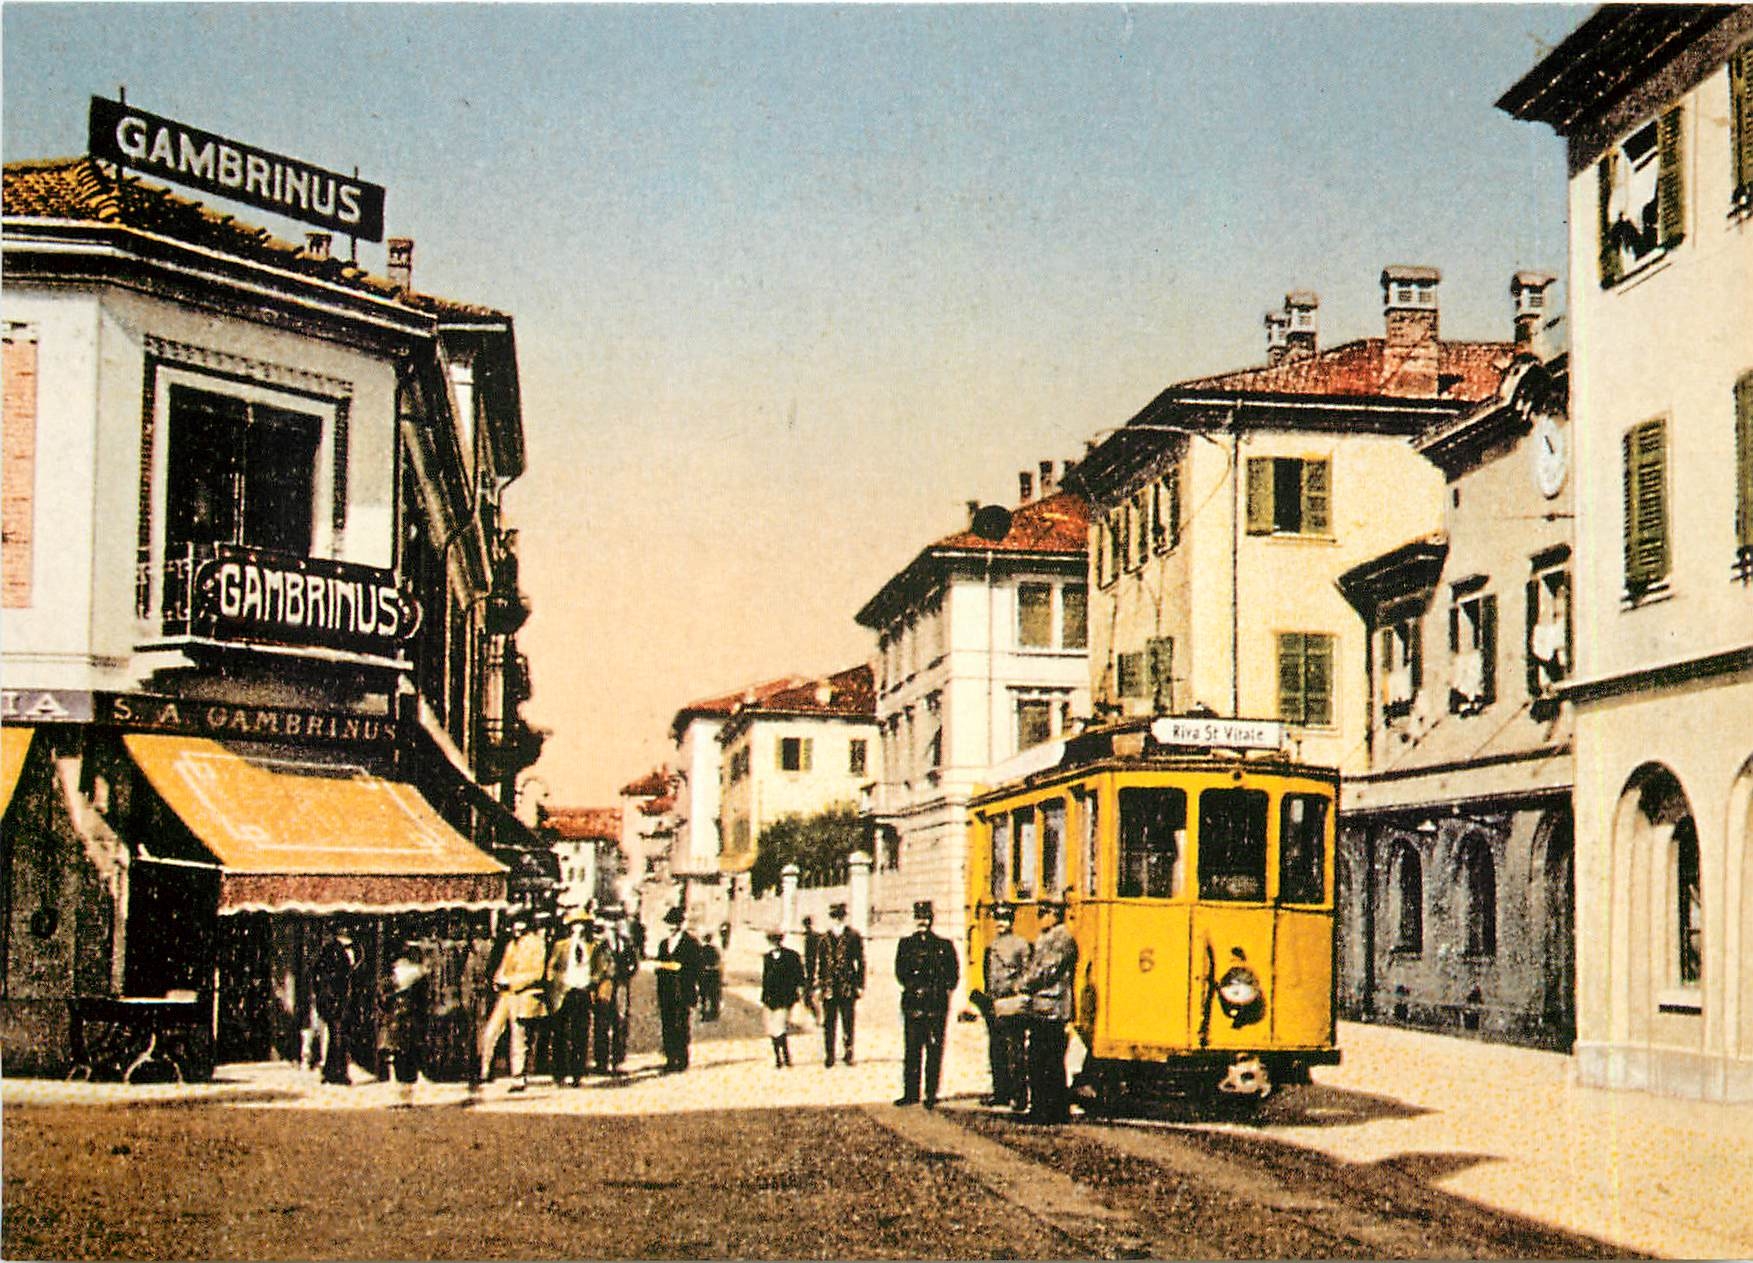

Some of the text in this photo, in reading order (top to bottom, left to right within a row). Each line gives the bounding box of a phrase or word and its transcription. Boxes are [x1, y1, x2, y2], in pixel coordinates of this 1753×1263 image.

[116, 117, 362, 224] GAMBRINUS
[220, 563, 401, 636] GAMBRINUS
[206, 706, 397, 741] GAMBRINUS
[1172, 724, 1200, 740] Riva
[1138, 946, 1155, 974] 6
